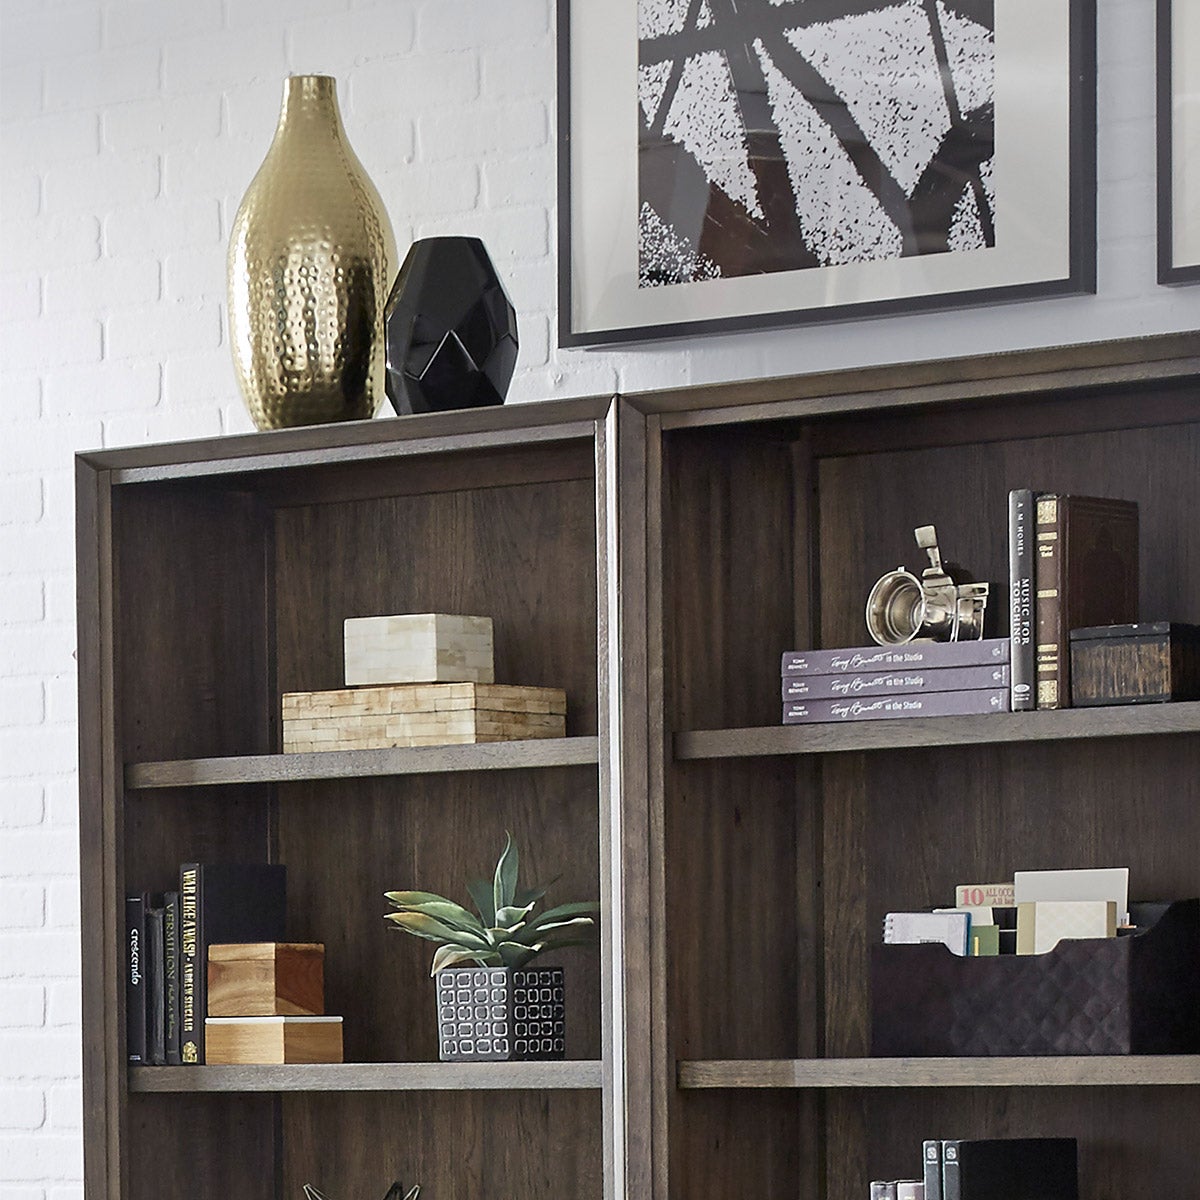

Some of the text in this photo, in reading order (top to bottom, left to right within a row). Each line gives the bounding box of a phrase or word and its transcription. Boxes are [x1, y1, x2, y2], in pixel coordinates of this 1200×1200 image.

[1013, 580, 1021, 645] TORCHING
[1021, 578, 1030, 646] MUSIC FOR
[892, 654, 903, 662] the
[904, 652, 923, 662] Studio
[894, 678, 904, 686] the
[904, 676, 924, 686] Studio
[892, 702, 902, 710] the
[903, 700, 922, 710] Studio
[183, 870, 196, 894] WAR
[986, 888, 998, 897] ALL
[183, 896, 196, 919] LIKE
[961, 888, 985, 906] 10
[166, 902, 175, 980] VERMILION
[183, 927, 196, 957] WASP
[130, 928, 142, 985] crescendo
